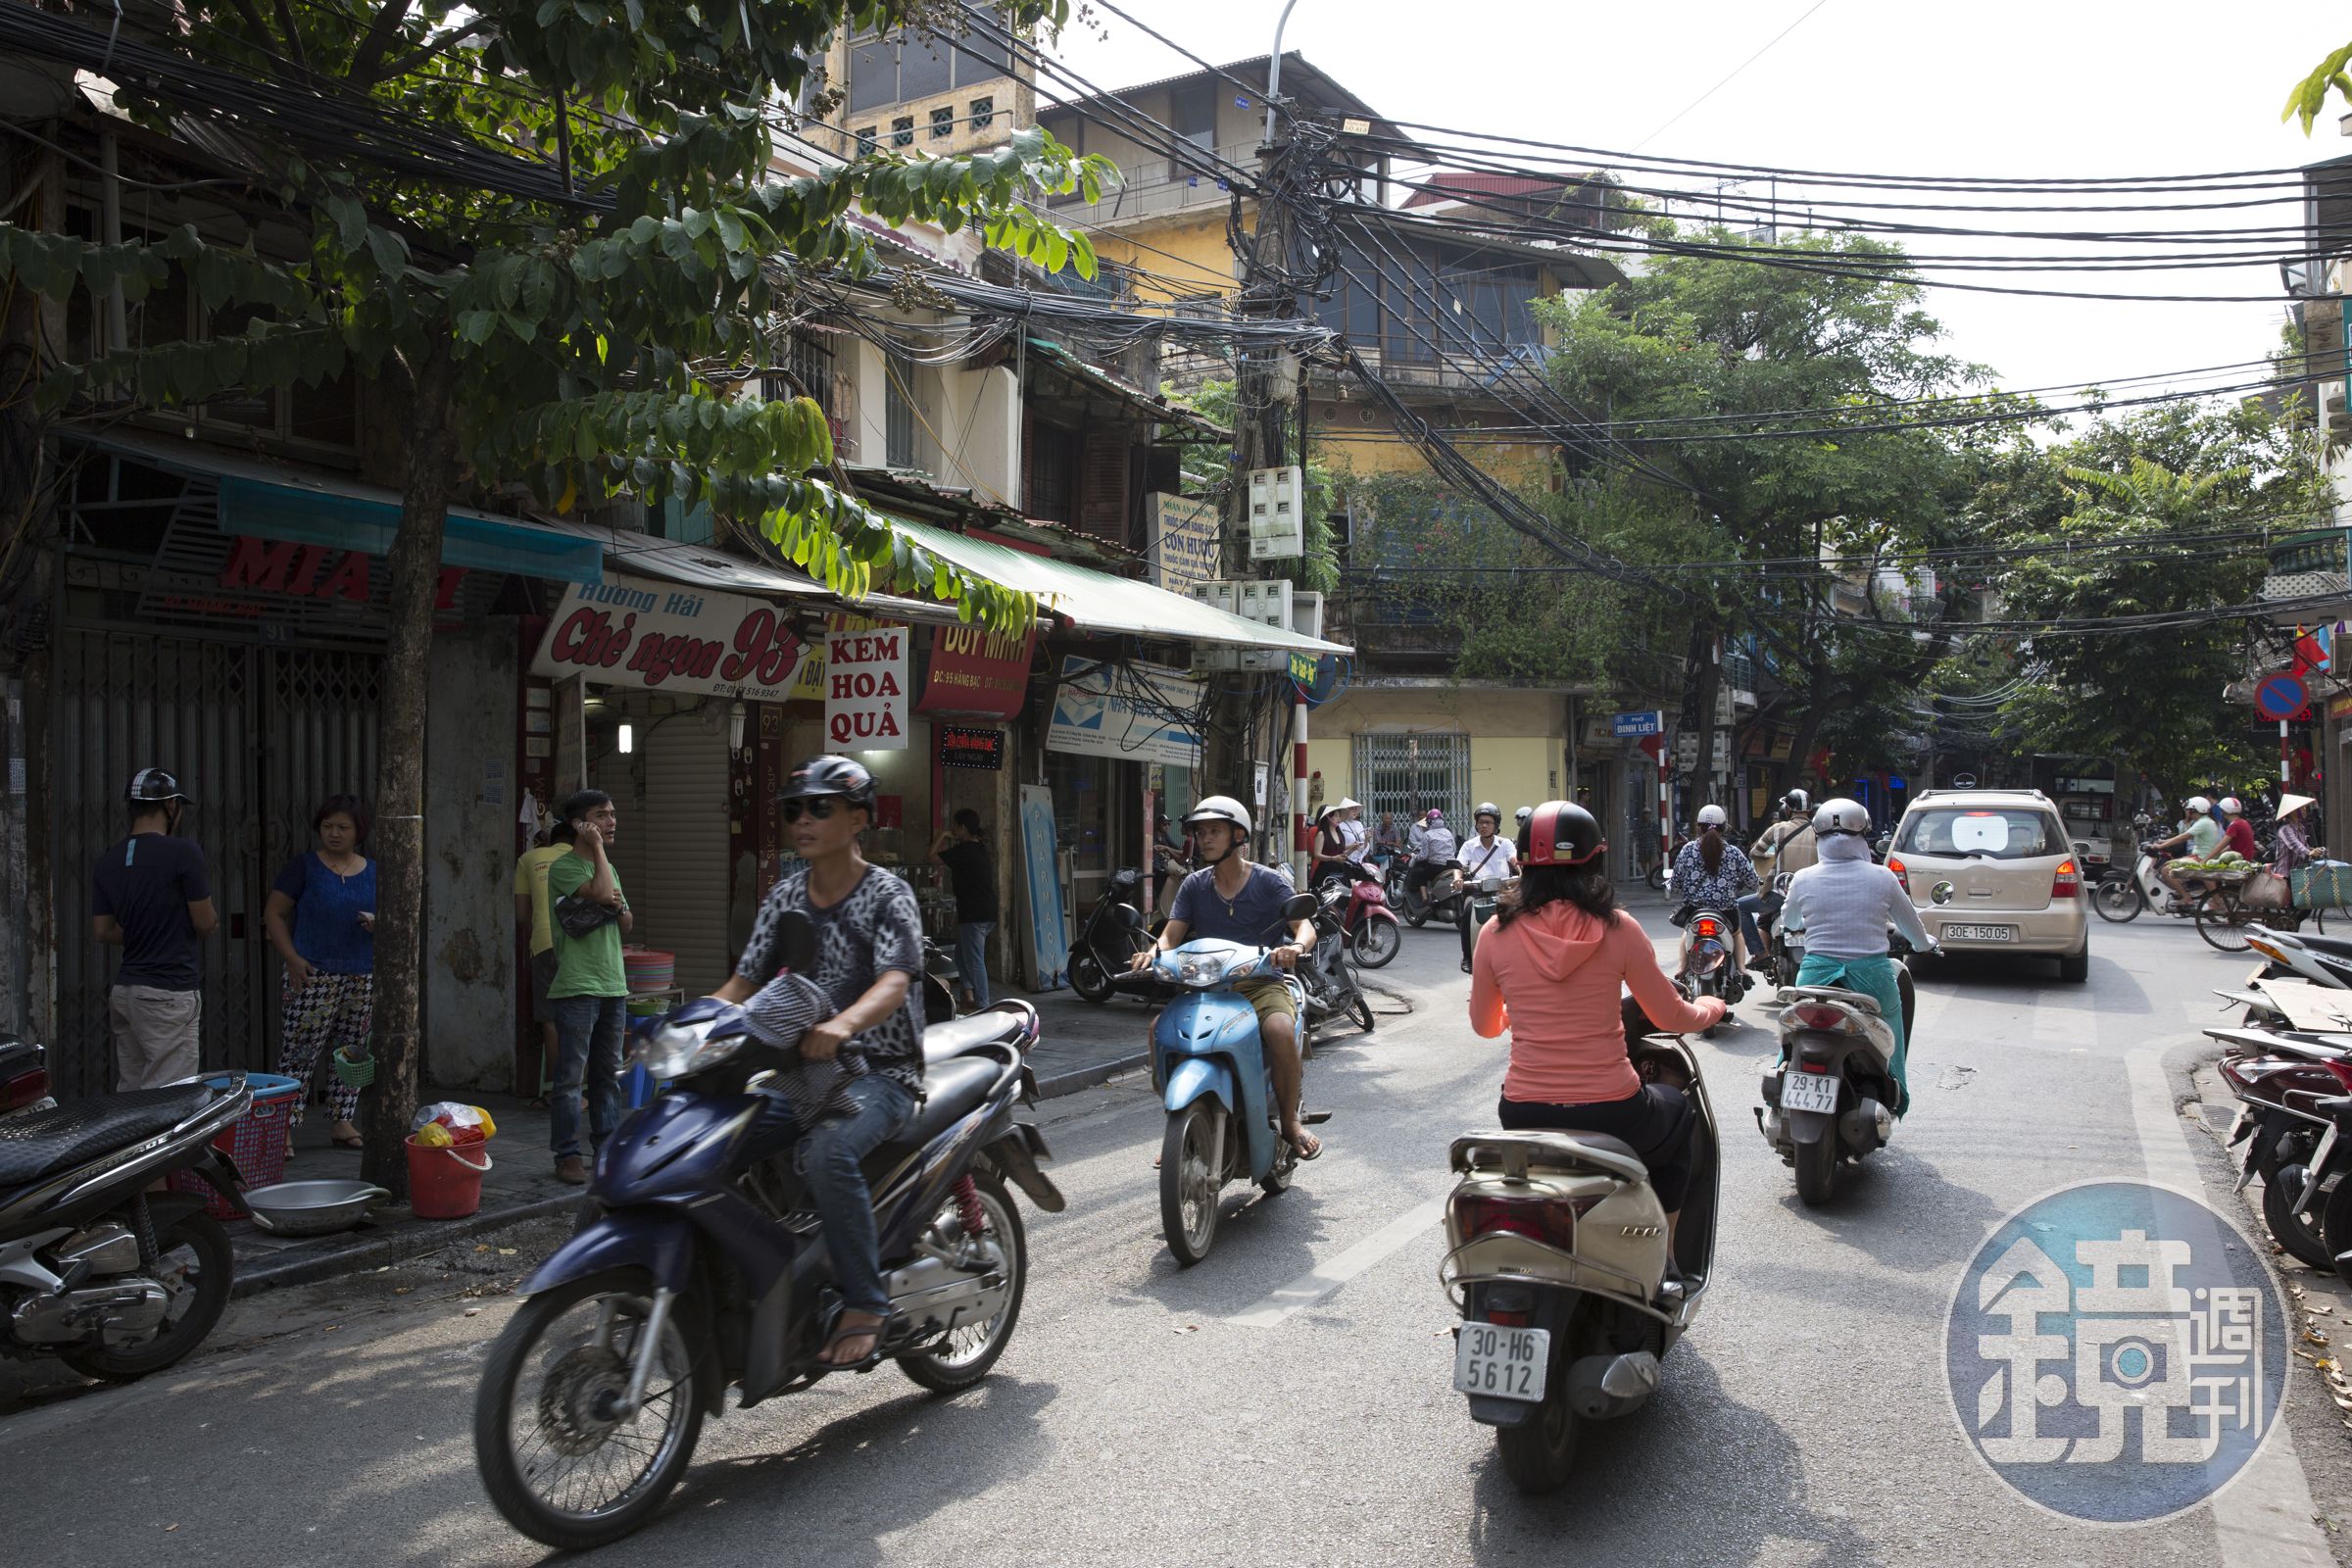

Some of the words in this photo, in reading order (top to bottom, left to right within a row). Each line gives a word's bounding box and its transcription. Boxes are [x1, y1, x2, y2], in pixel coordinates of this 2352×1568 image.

[1164, 531, 1185, 553] CON
[662, 594, 706, 617] Hải
[267, 624, 287, 640] 91
[945, 627, 981, 656] DUY
[625, 632, 724, 685] ngon
[719, 608, 800, 685] 93
[830, 636, 900, 664] KEM
[831, 671, 901, 699] HOA
[761, 713, 778, 733] 93
[830, 702, 901, 744] QUẢ
[1617, 724, 1637, 734] ĐINH
[1639, 722, 1655, 735] LIỆT
[1035, 810, 1056, 964] PHARMACY
[1949, 926, 2008, 939] 30E-150.05
[1791, 1075, 1831, 1094] 29-K1
[1785, 1091, 1835, 1110] 444.77
[1471, 1329, 1534, 1362] 30-H6
[1467, 1358, 1531, 1394] 5612
